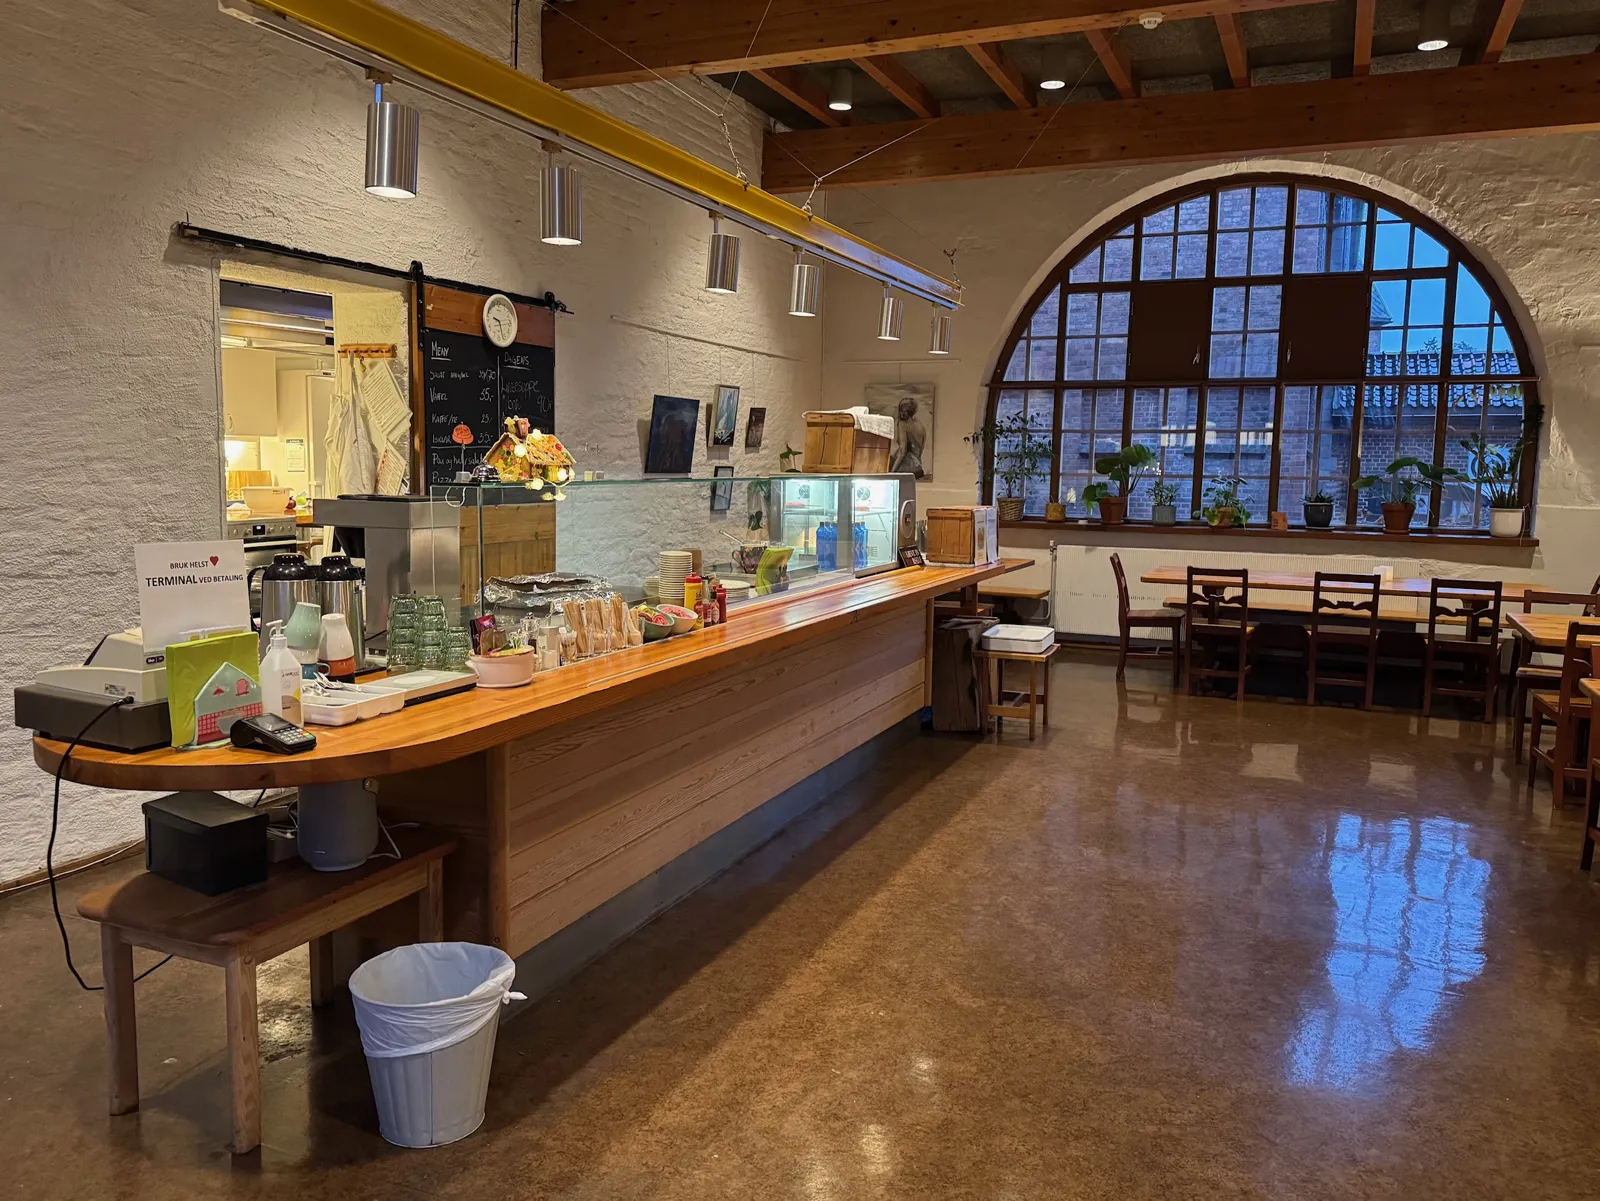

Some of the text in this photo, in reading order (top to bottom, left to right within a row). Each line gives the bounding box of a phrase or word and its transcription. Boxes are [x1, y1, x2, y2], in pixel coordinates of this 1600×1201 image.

[169, 560, 208, 570] BRUK HELST
[145, 575, 198, 587] TERMINAL
[213, 574, 244, 583] BETALING
